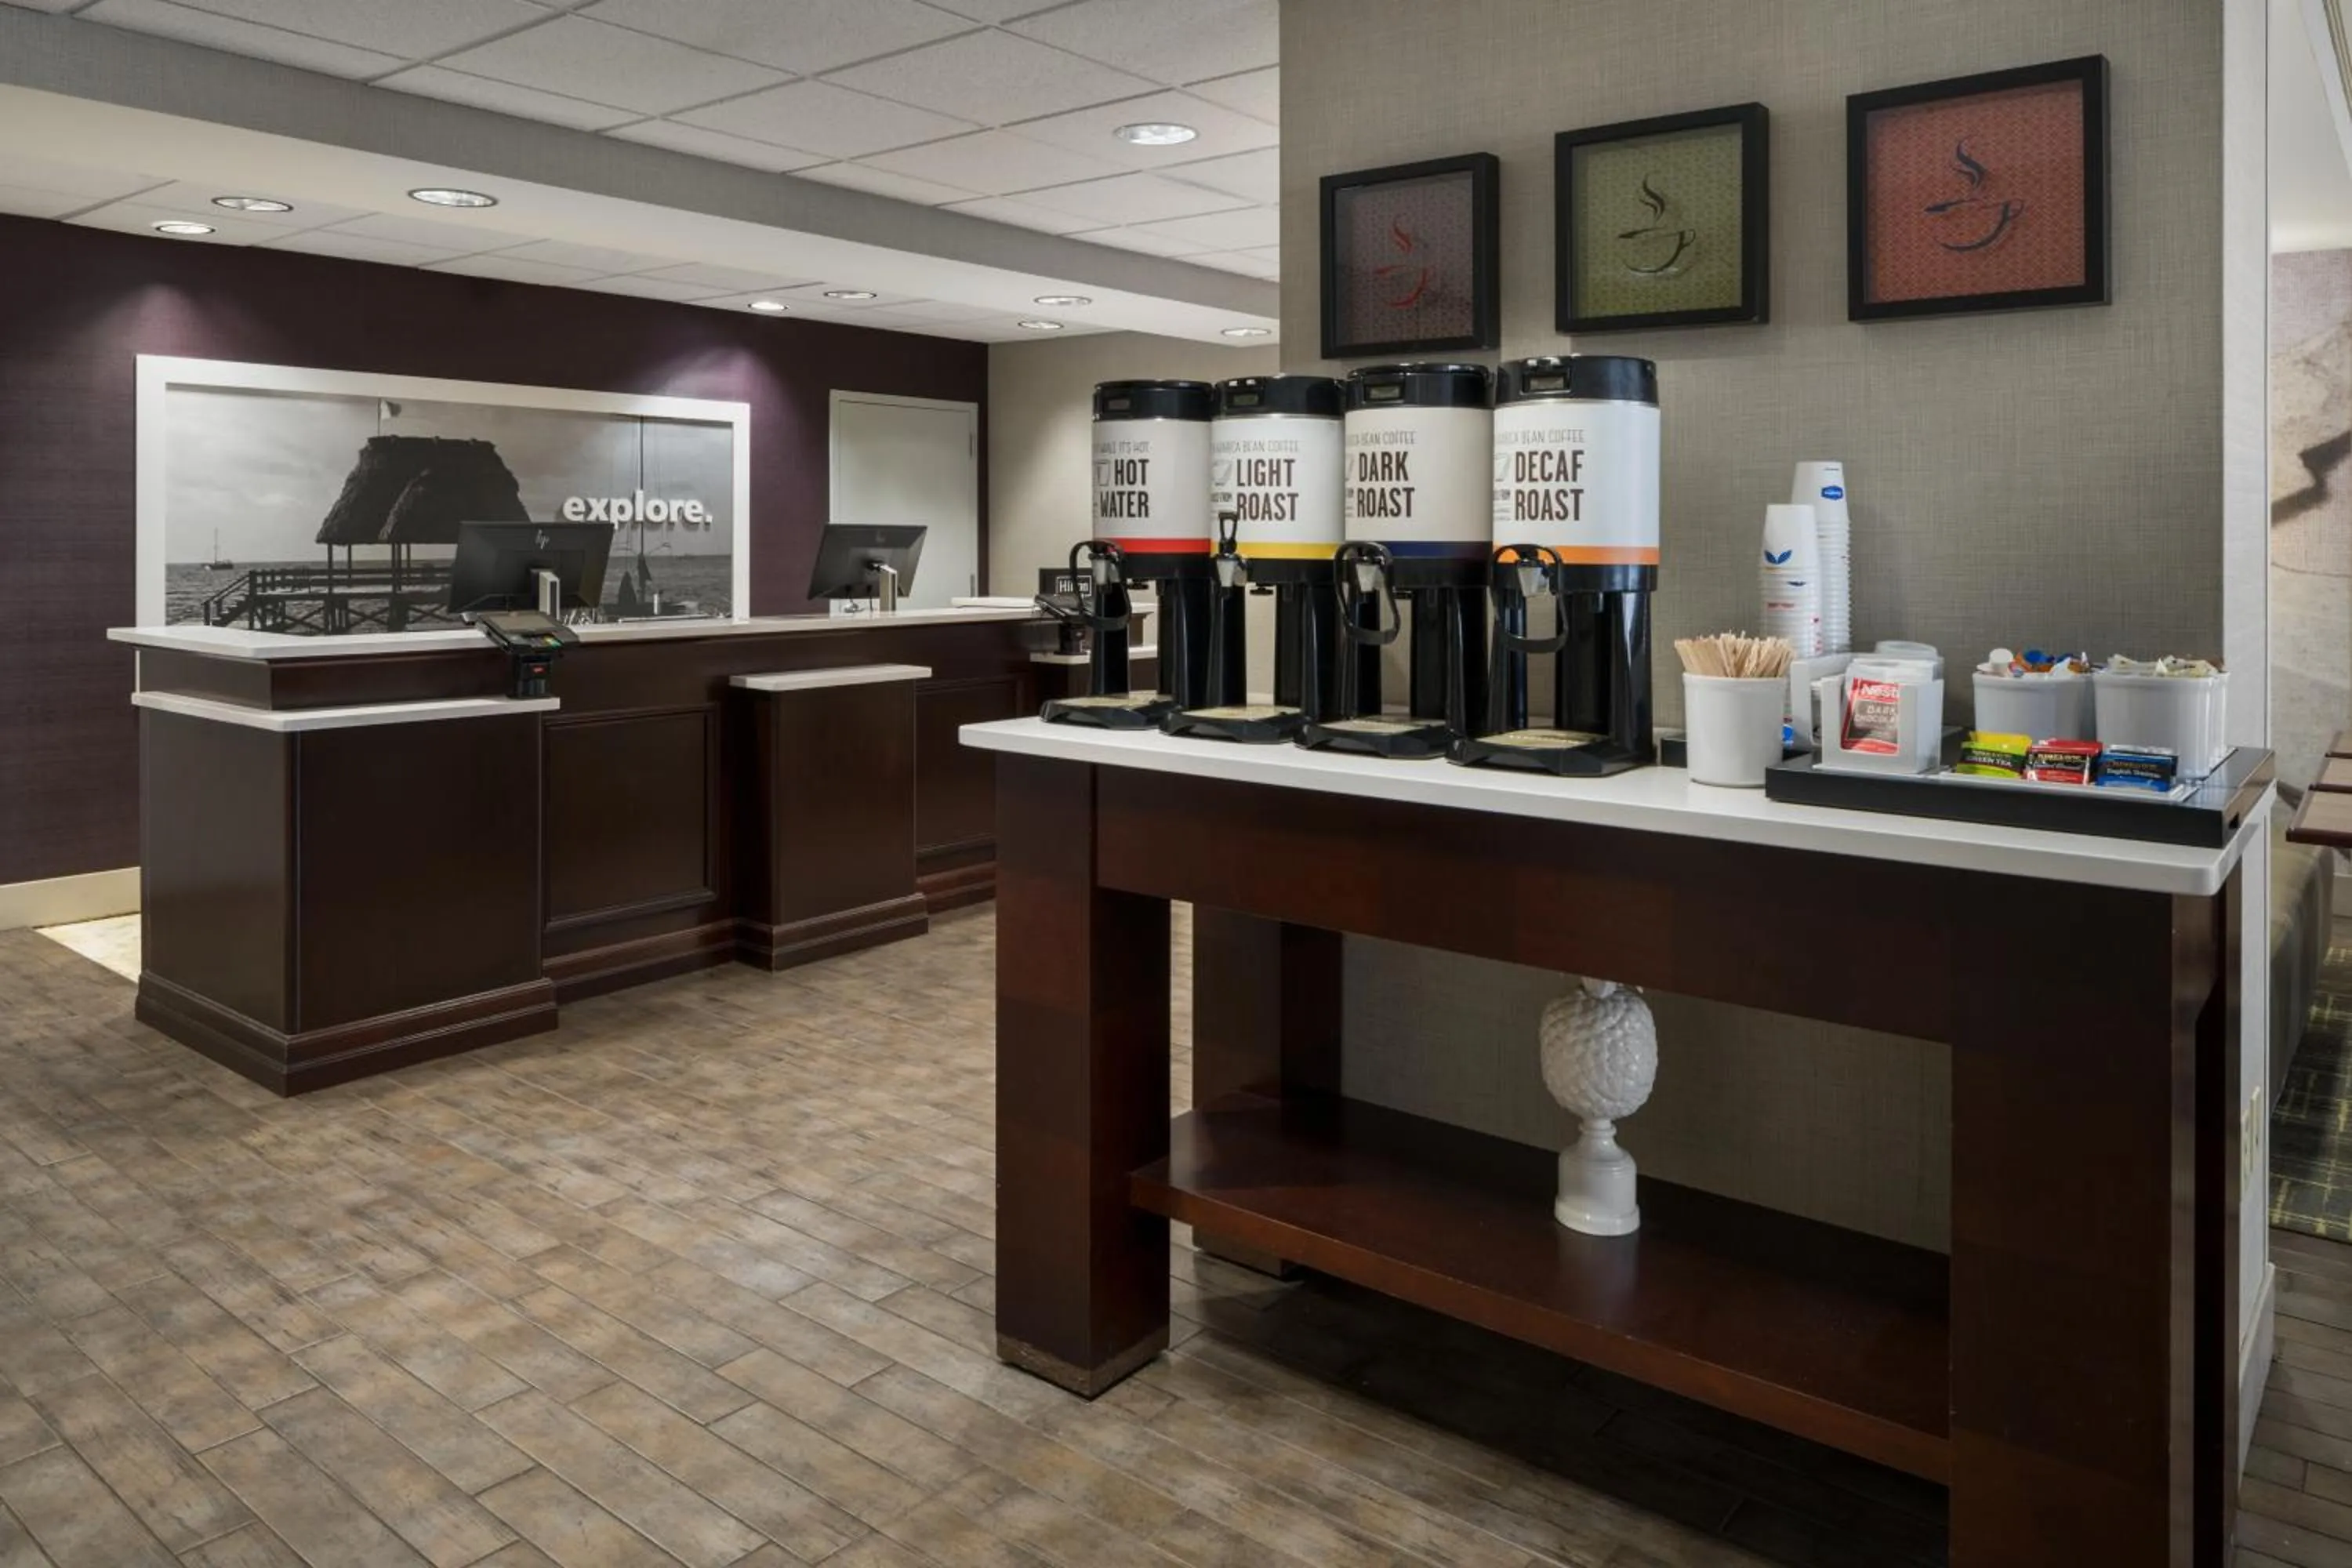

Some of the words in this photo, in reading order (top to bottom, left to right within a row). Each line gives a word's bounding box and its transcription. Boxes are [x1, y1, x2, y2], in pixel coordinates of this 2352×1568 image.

[1548, 428, 1584, 443] COFFEE
[1115, 459, 1150, 486] HOT
[1236, 459, 1296, 486] LIGHT
[1359, 451, 1409, 482] DARK
[1515, 450, 1584, 483] DECAF
[562, 489, 713, 530] explore.
[1100, 490, 1149, 518] WATER
[1236, 492, 1299, 521] ROAST
[1357, 487, 1415, 517] ROAST
[1515, 488, 1584, 521] ROAST
